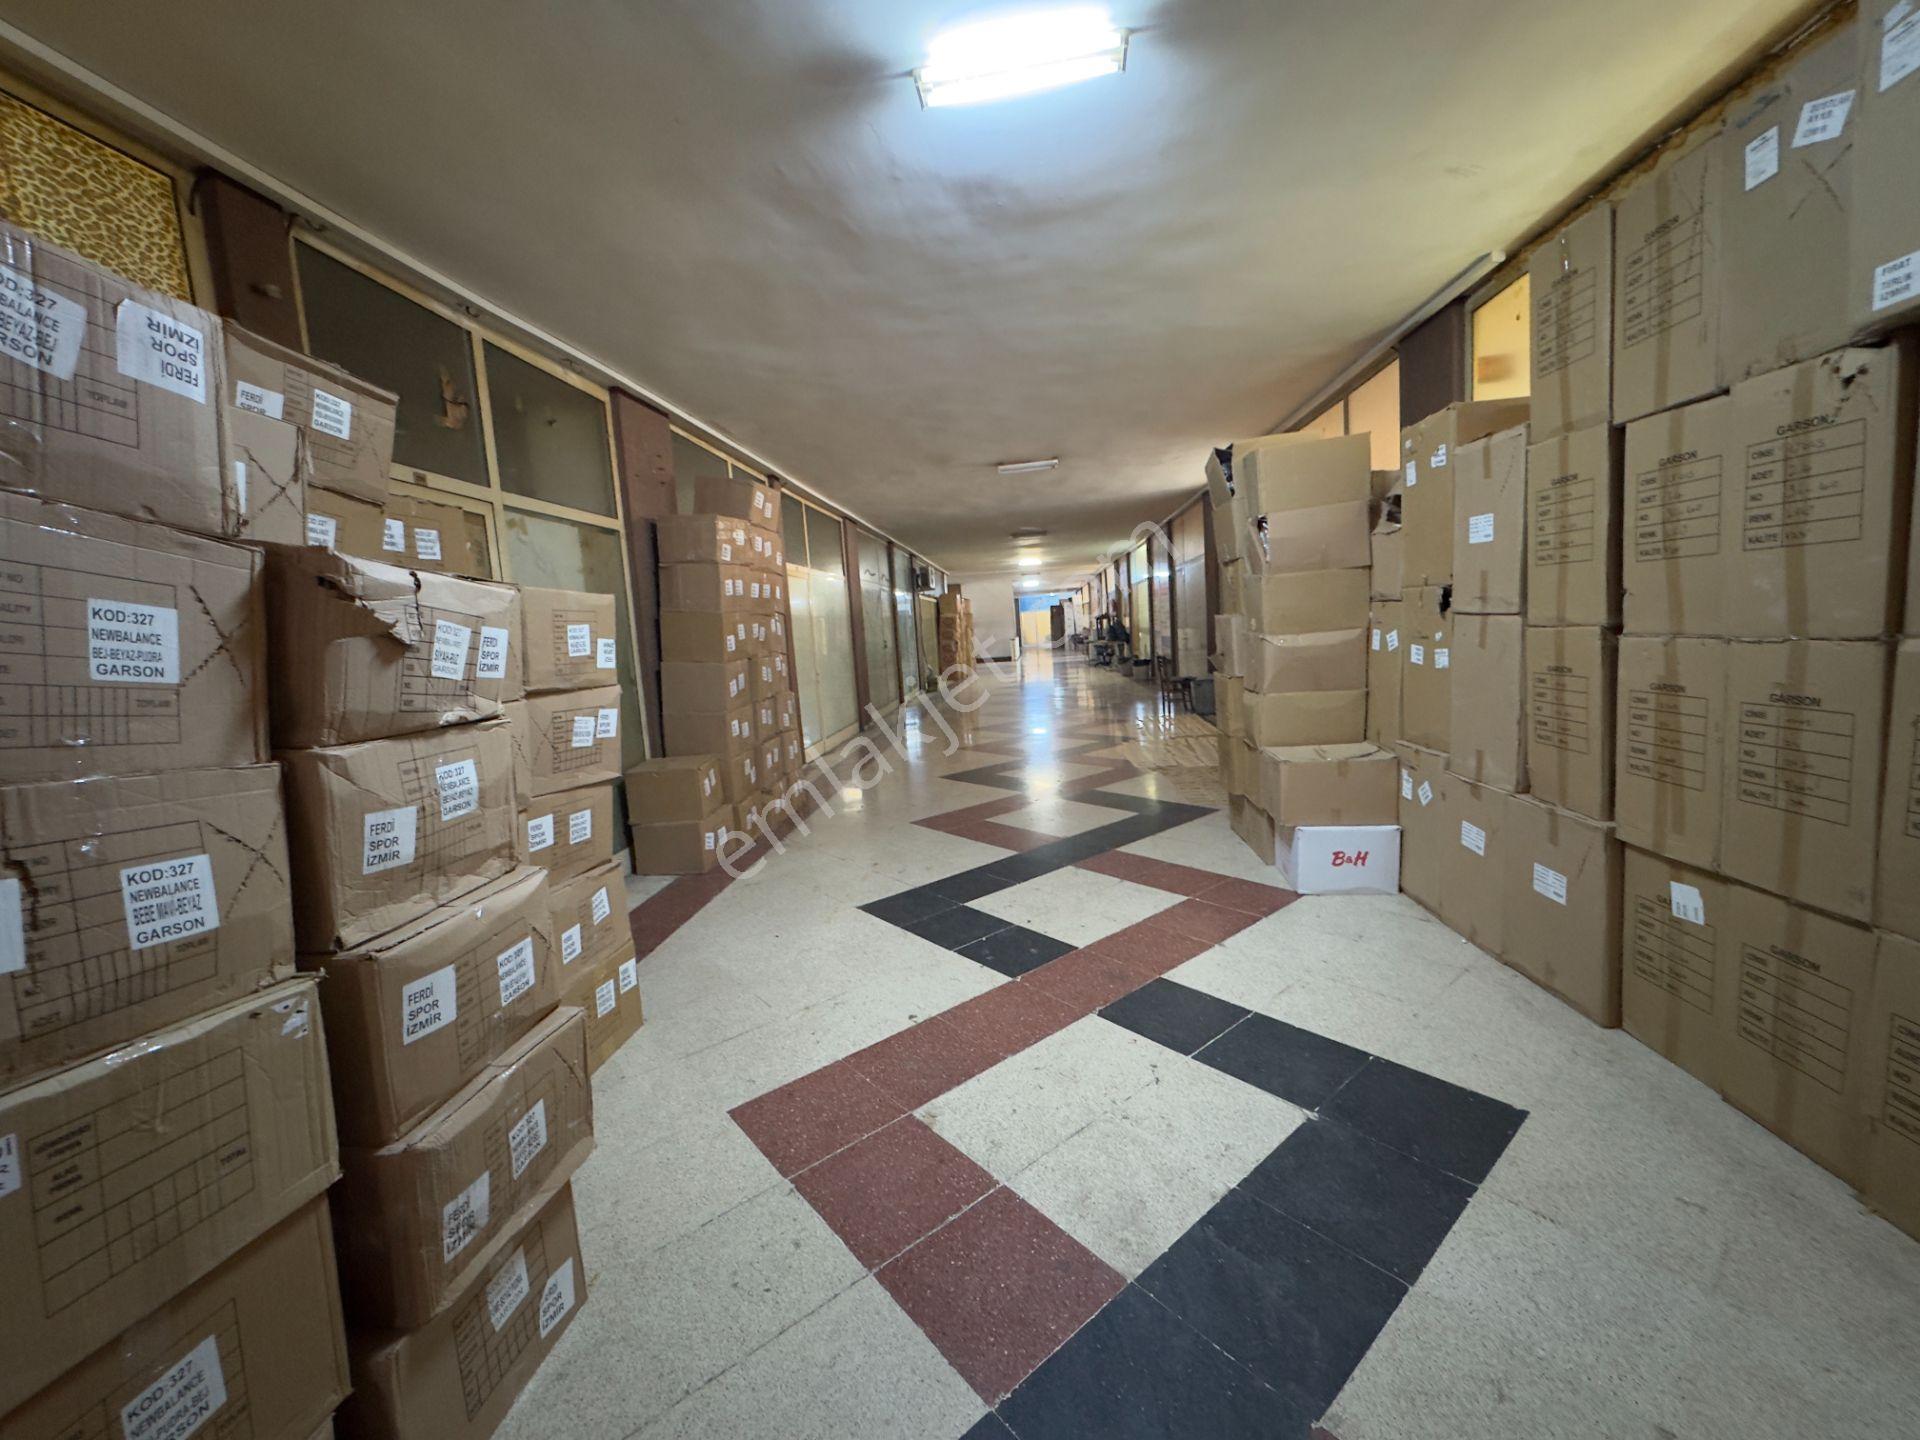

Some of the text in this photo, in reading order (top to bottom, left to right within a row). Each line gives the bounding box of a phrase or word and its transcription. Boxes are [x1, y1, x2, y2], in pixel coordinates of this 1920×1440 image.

[150, 336, 198, 367] SPOR
[92, 607, 155, 627] KOD:327
[91, 627, 163, 646] NEWBALANCE
[96, 664, 165, 678] GARSON
[369, 817, 395, 836] FERDİ
[369, 837, 399, 852] SPOR
[367, 850, 400, 867] İZMİR
[1331, 851, 1369, 867] B&H
[126, 862, 195, 887] KOD:327
[129, 878, 200, 904] NEWBALANCE
[136, 917, 205, 945] GARSON
[408, 982, 434, 1006] FERDİ
[408, 1000, 439, 1021] SPOR
[406, 1012, 442, 1037] İZMİR
